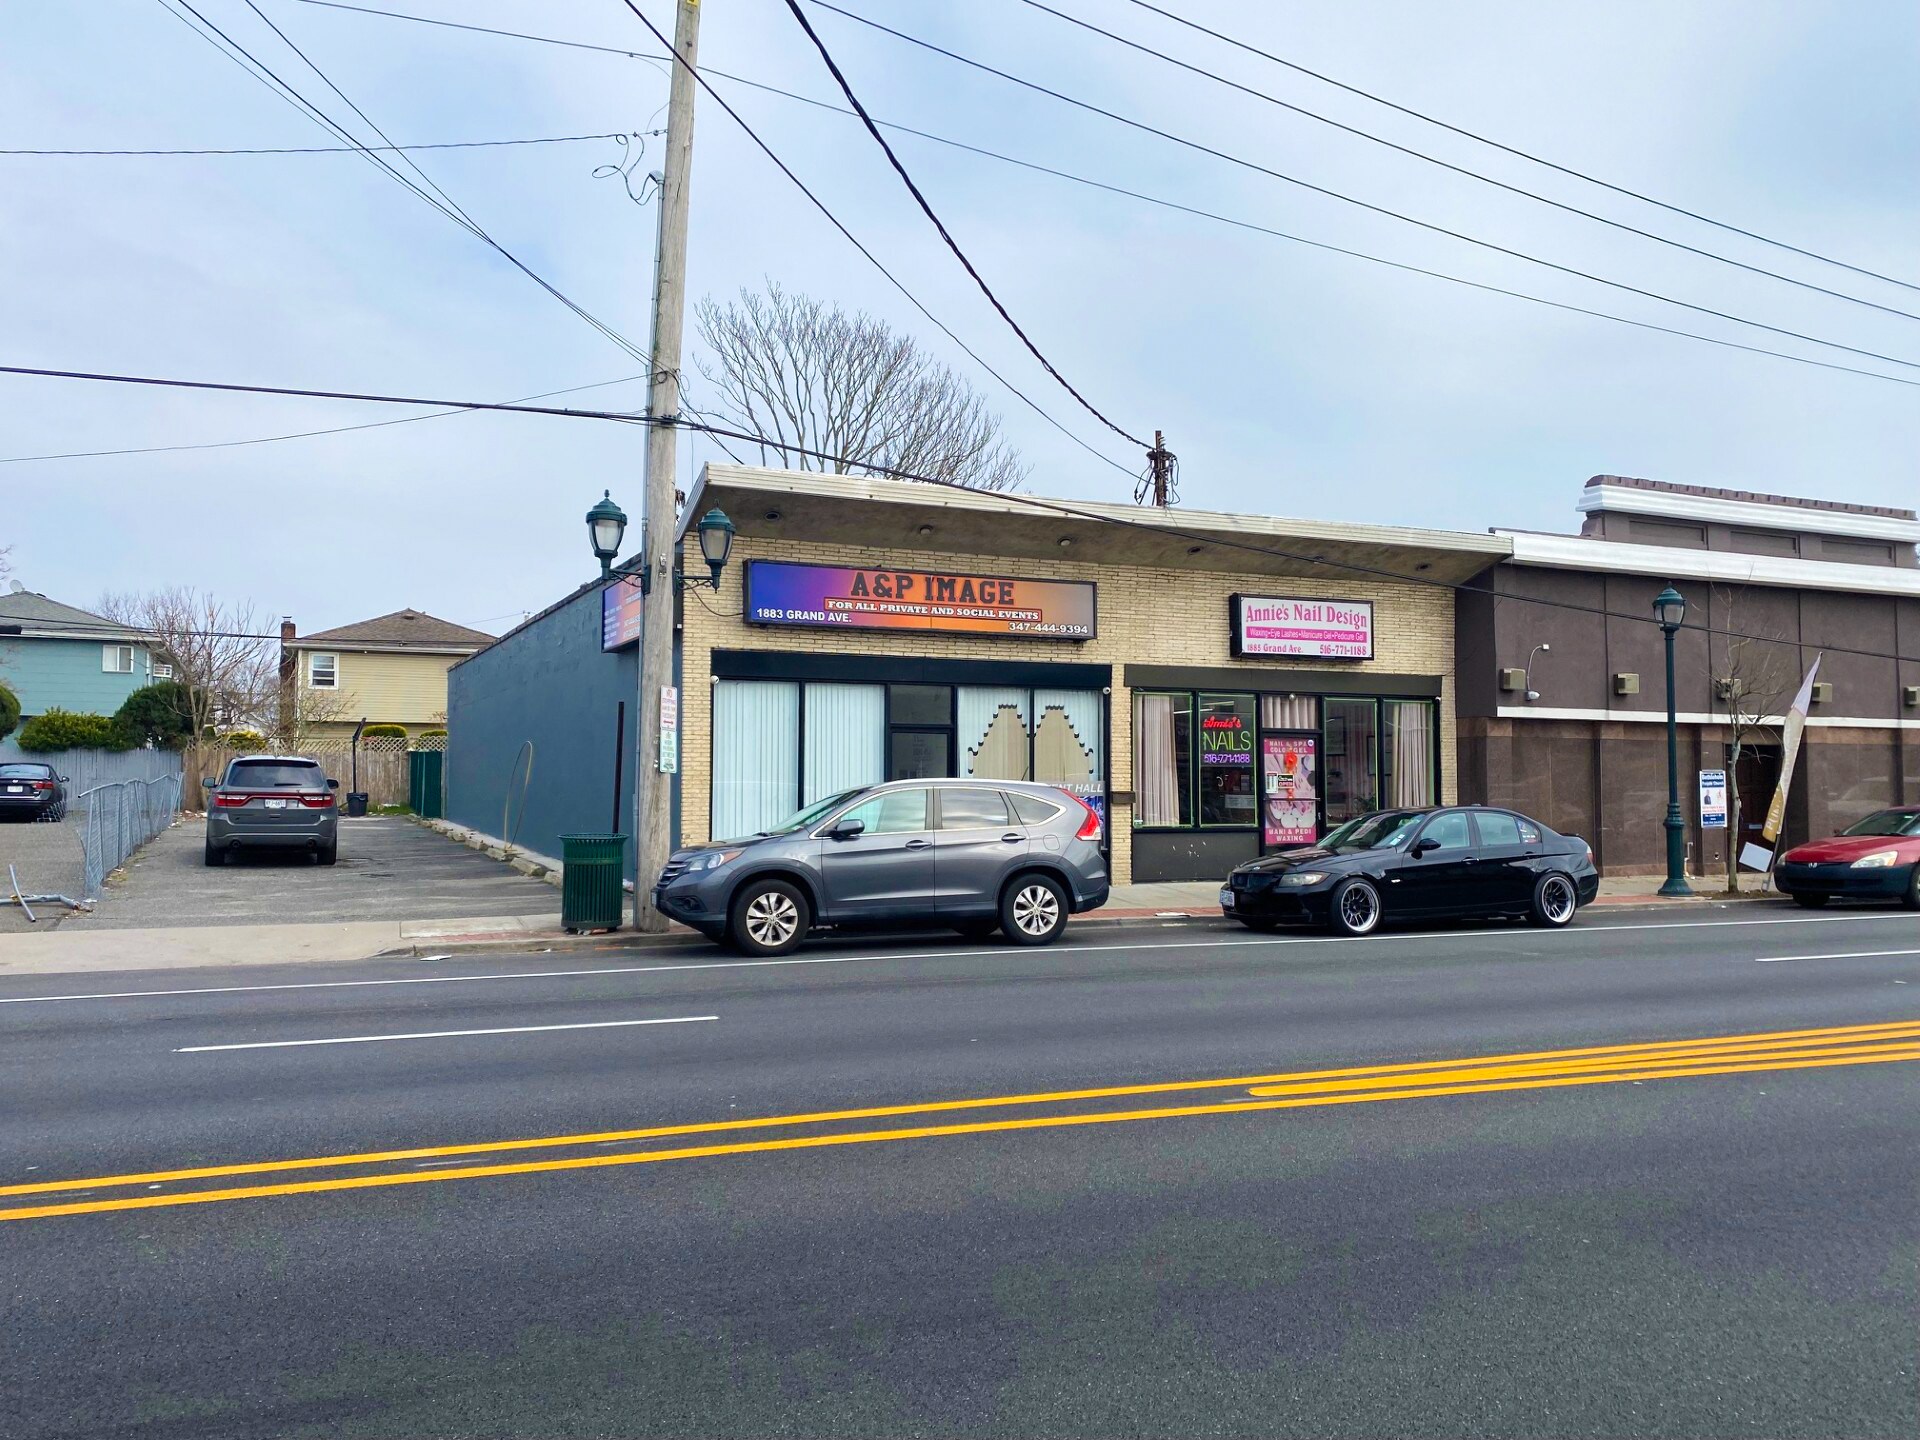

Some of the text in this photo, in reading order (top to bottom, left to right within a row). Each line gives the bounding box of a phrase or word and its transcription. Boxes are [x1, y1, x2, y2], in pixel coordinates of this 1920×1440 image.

[851, 572, 1015, 605] A&P IMAGE
[757, 608, 852, 623] 1883 GRAND AVE.
[828, 601, 1039, 621] FOR ALL PRIVATE AND SOCIAL EVENTS
[1246, 604, 1367, 629] Annie's Nail Design
[1008, 622, 1088, 634] 347-444-9394
[1271, 629, 1280, 639] Eye
[1264, 643, 1287, 653] Grand
[1320, 645, 1366, 655] 516-771-1188
[1203, 731, 1251, 751] NAILS
[1203, 753, 1251, 764] 516-771-1188
[1075, 783, 1103, 792] HALL
